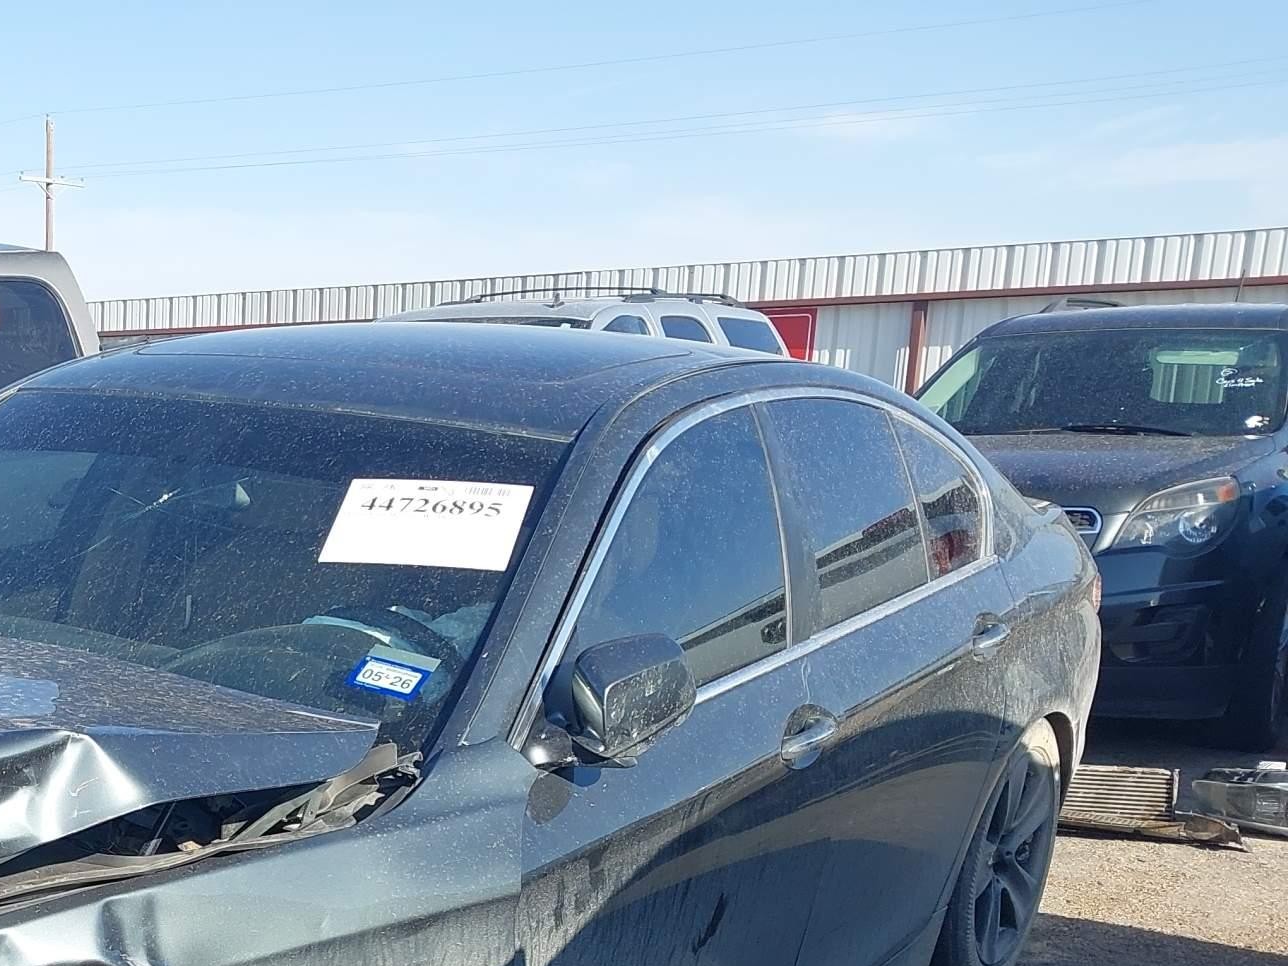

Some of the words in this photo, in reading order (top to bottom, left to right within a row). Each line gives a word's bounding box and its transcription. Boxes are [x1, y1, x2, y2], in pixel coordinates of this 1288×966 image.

[361, 496, 503, 518] 44726895
[362, 668, 383, 682] 05
[389, 675, 413, 690] 26
